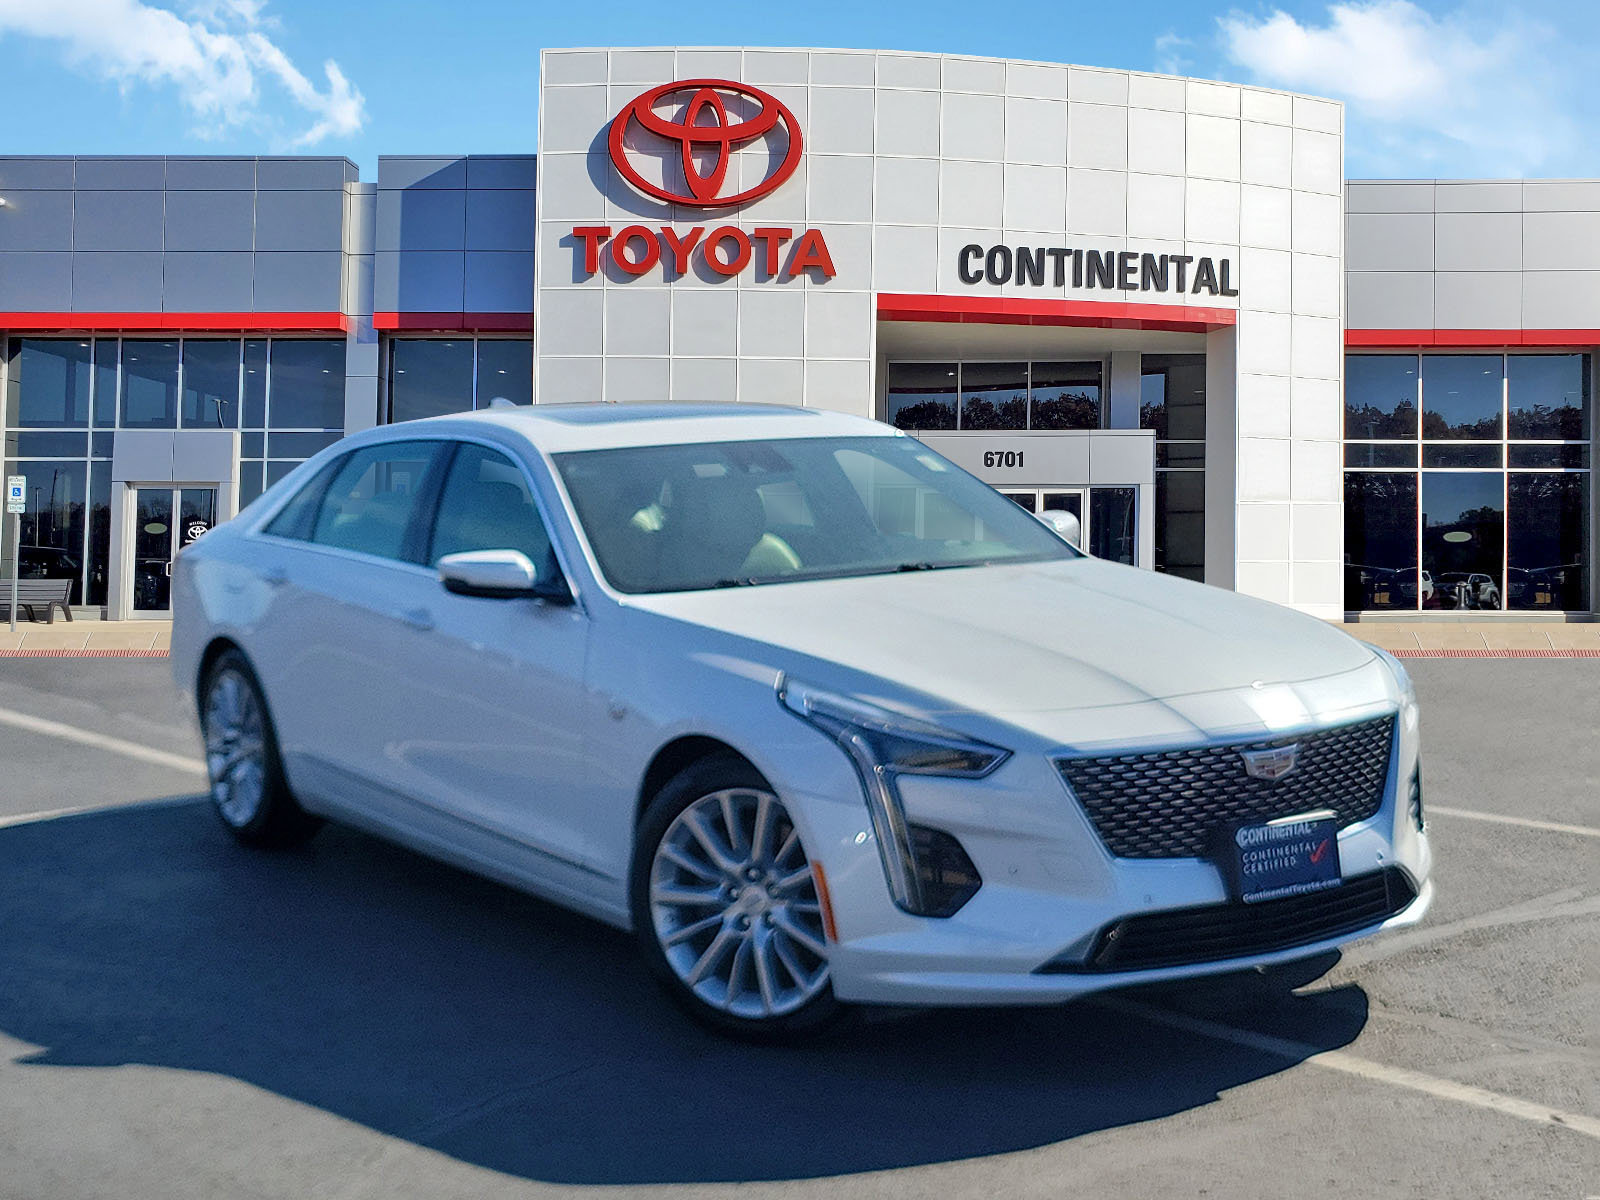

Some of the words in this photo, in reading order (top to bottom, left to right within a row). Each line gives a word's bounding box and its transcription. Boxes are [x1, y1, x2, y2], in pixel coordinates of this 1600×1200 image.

[572, 225, 836, 277] TOYOTA
[958, 244, 1239, 296] CONTINENTAL
[983, 451, 1024, 468] 6701
[1241, 823, 1311, 844] CONTINENTAL
[1242, 841, 1317, 862] CONTINENTAL
[1243, 856, 1296, 874] CERTIFIED
[1243, 879, 1341, 901] ContinentalToyota.com
